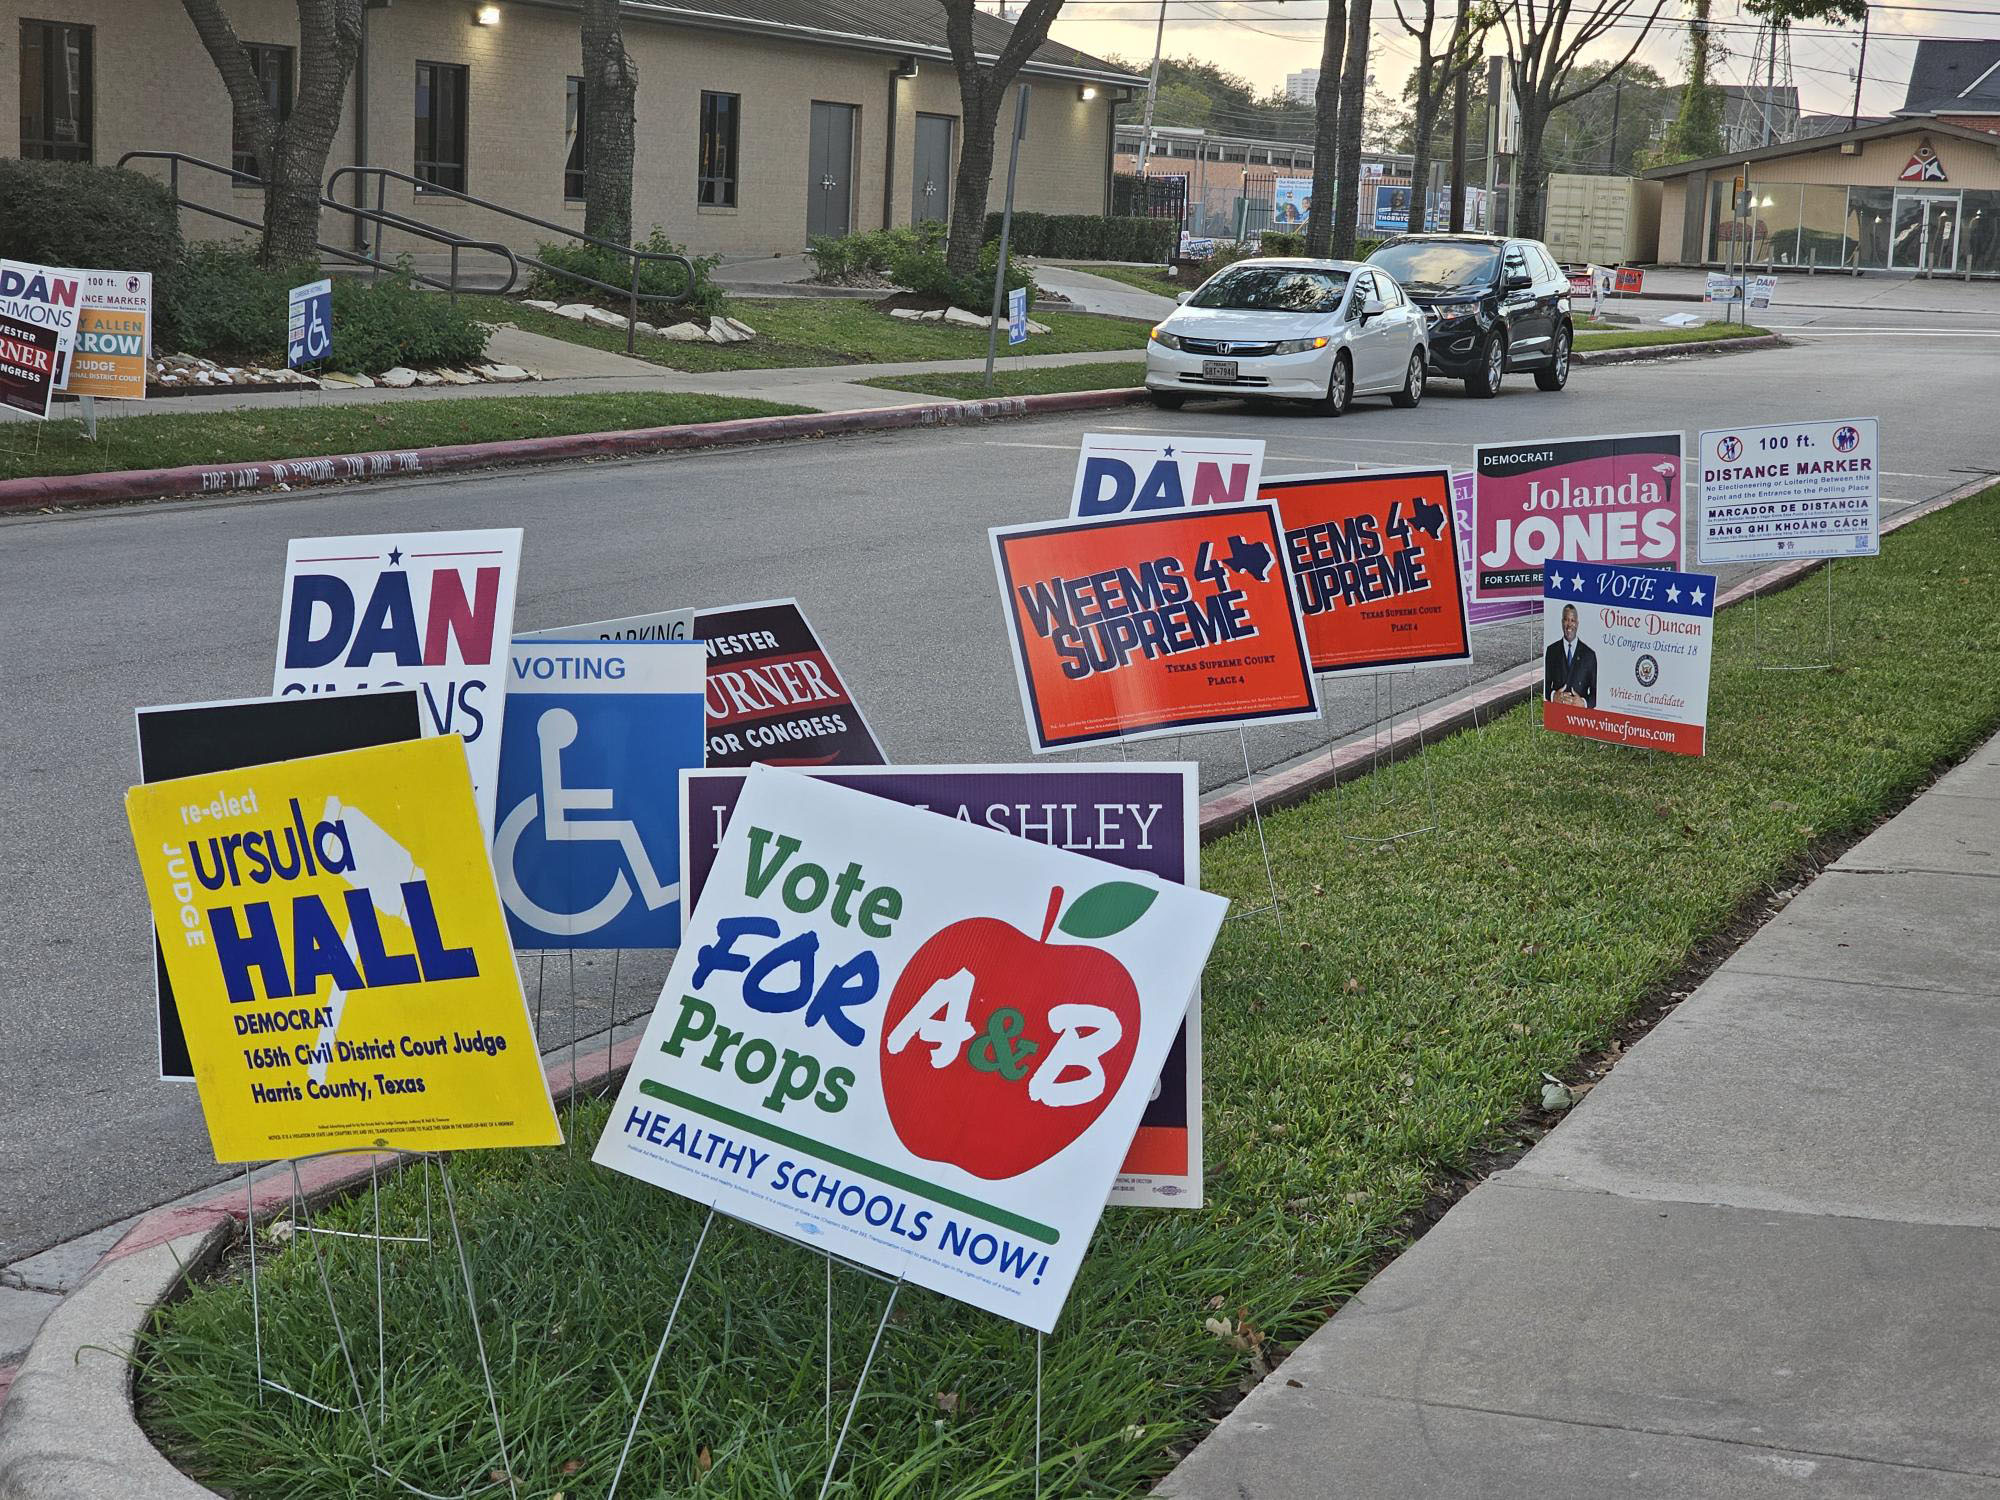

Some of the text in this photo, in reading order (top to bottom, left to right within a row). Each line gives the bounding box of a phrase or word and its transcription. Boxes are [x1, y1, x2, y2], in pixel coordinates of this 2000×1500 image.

[0, 270, 79, 308] DAN
[88, 277, 117, 288] 100 ft.
[1756, 279, 1776, 287] DAN
[107, 298, 147, 306] MARKER
[95, 319, 142, 332] ALLEN
[77, 360, 116, 372] JUDGE
[1760, 435, 1815, 451] 100 ft.
[1483, 452, 1553, 466] DEMOCRAT!
[1705, 458, 1872, 482] DISTANCE MARKER
[1078, 457, 1250, 517] DAN
[1522, 473, 1661, 511] Jolanda
[1707, 494, 1726, 502] Point
[1744, 491, 1756, 499] the
[1758, 489, 1791, 497] Entrance
[1818, 485, 1845, 494] Polling
[1718, 478, 1772, 492] Electioneering
[1784, 477, 1818, 487] Loitering
[1820, 475, 1853, 484] Between
[1708, 505, 1775, 519] MARCADOR
[1781, 504, 1796, 513] DE
[1802, 499, 1869, 511] DISTANCIA
[1386, 501, 1413, 550] 4
[1480, 508, 1677, 568] JONES
[1748, 524, 1769, 534] GHI
[1017, 541, 1229, 638] WEEMS 4
[1484, 574, 1503, 585] FOR
[1505, 573, 1531, 584] STATE
[1597, 570, 1657, 600] VOTE
[285, 566, 501, 669] DAN
[600, 621, 684, 641] KING
[1600, 608, 1701, 636] Vince Duncan
[1051, 590, 1258, 681] SUPREME
[1603, 633, 1698, 656] US Congress District 18
[512, 657, 626, 680] VOTING
[1239, 675, 1244, 684] 4
[1609, 687, 1685, 708] Write-in Candidate
[745, 713, 848, 749] CONGRESS
[1566, 714, 1676, 743] www.vinceforus.com
[179, 787, 260, 825] re-elect
[915, 803, 1163, 849] SHLEY
[187, 797, 357, 891] ursula
[162, 842, 206, 948] JUDGE
[744, 825, 903, 939] Vote
[206, 879, 480, 1004] HALL
[691, 916, 880, 1048] FOR
[234, 1006, 333, 1036] DEMOCRAT
[244, 1030, 507, 1070] 165th Civil District Court Judge
[659, 993, 856, 1116] Props
[251, 1073, 425, 1104] Harris County, Texas
[623, 1105, 1050, 1286] HEALTHY SCHOOLS NOW!
